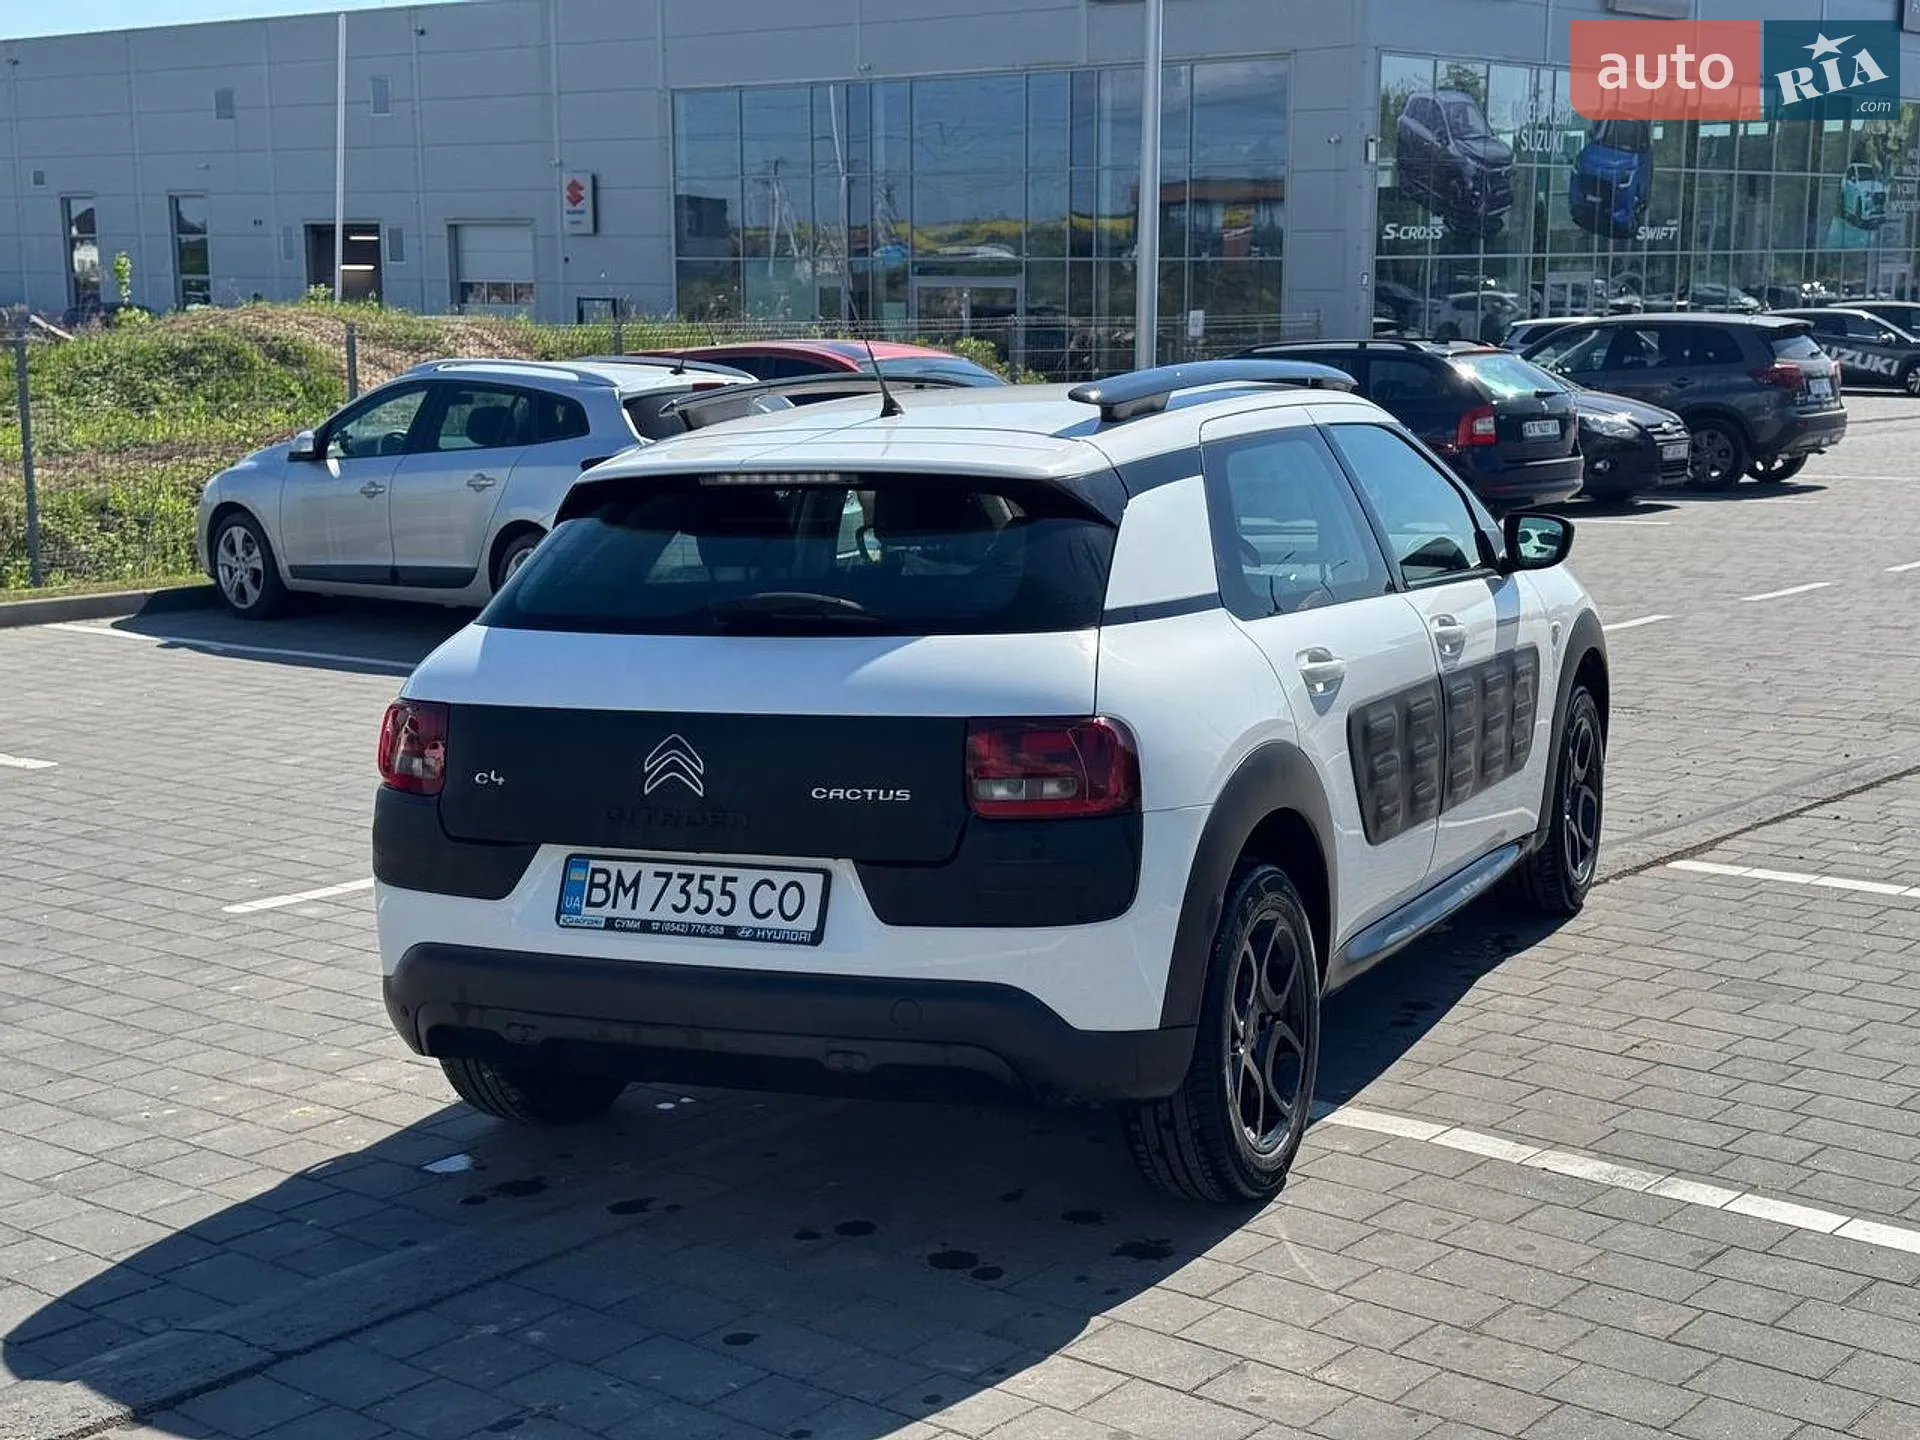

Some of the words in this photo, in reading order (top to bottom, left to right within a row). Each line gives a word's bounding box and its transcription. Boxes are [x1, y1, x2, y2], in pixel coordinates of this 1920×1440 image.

[1520, 129, 1565, 153] SUZUKI
[1636, 226, 1678, 240] SWIFT
[811, 786, 911, 802] CACTUS
[565, 895, 581, 909] UA
[585, 867, 643, 910] BM
[649, 871, 739, 917] 7355
[748, 877, 806, 922] CO
[756, 928, 812, 943] HYUNDAI
